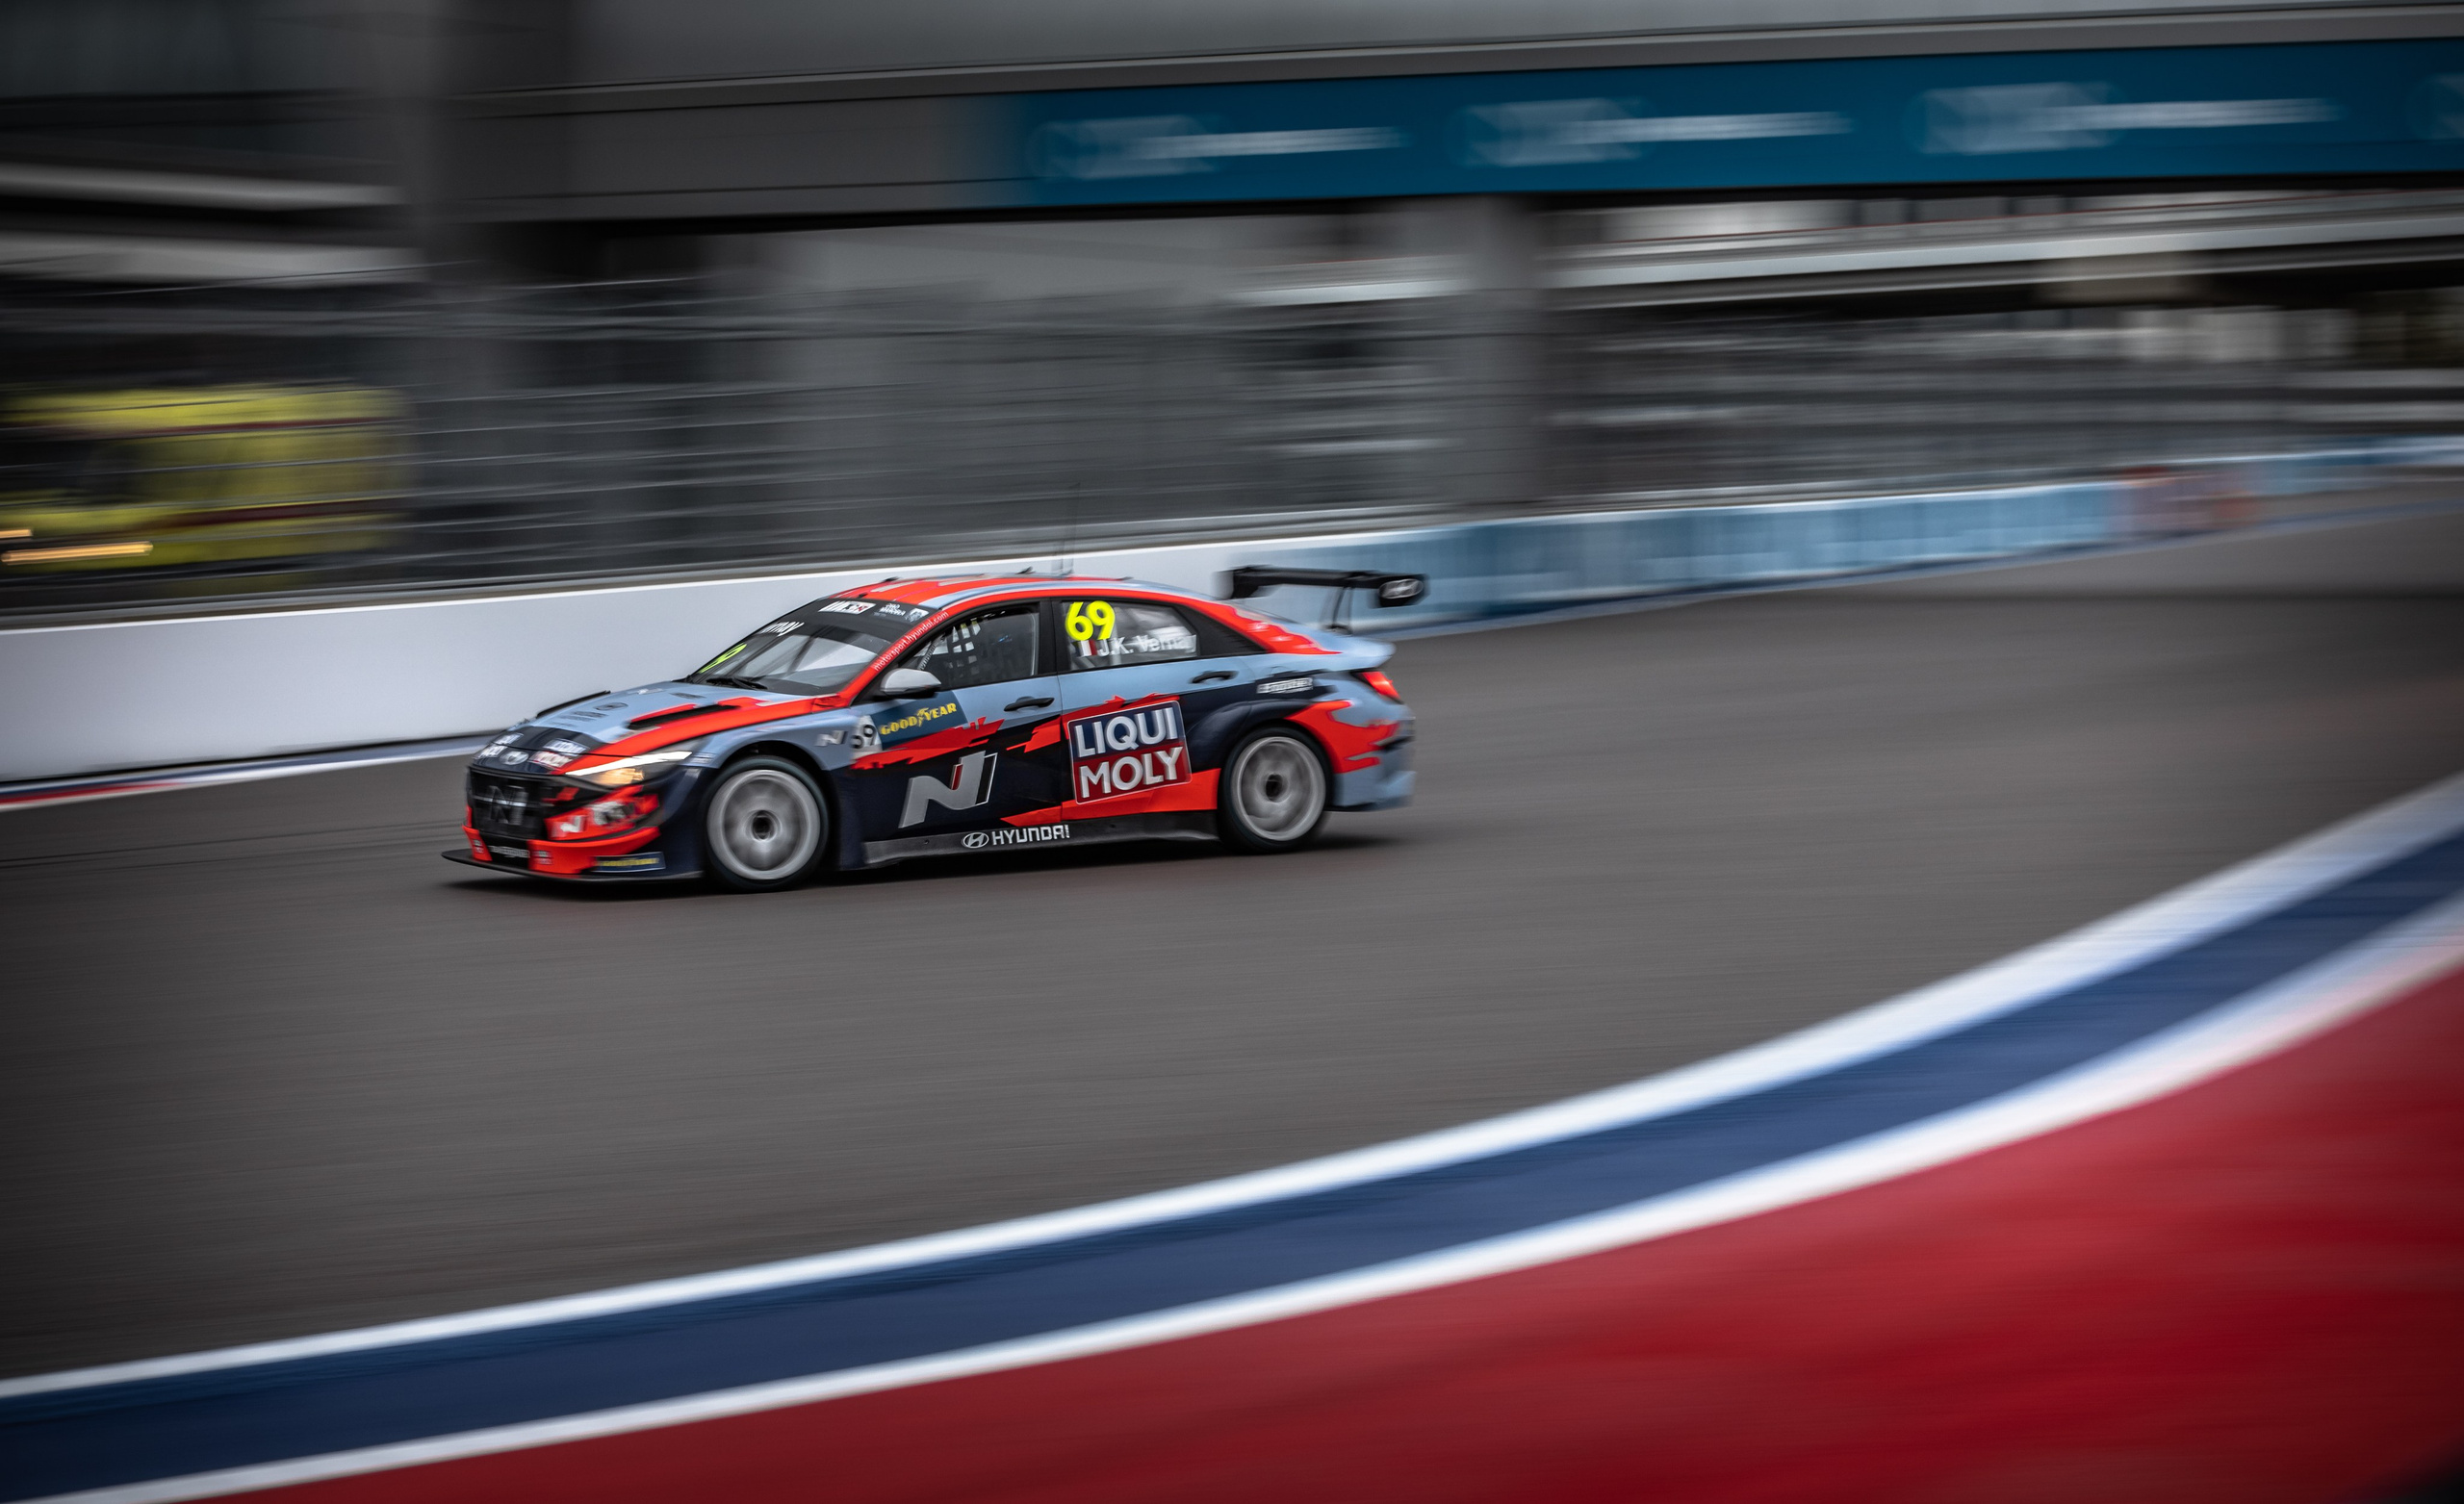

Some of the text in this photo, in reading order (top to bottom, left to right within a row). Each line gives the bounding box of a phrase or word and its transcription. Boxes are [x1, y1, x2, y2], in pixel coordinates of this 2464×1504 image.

[873, 611, 949, 672] motorsport.hyundai.com
[1065, 600, 1116, 641] 69
[1075, 707, 1178, 757] LIQUI
[1080, 747, 1183, 799] MOLY
[991, 824, 1070, 845] HYUNDAI
